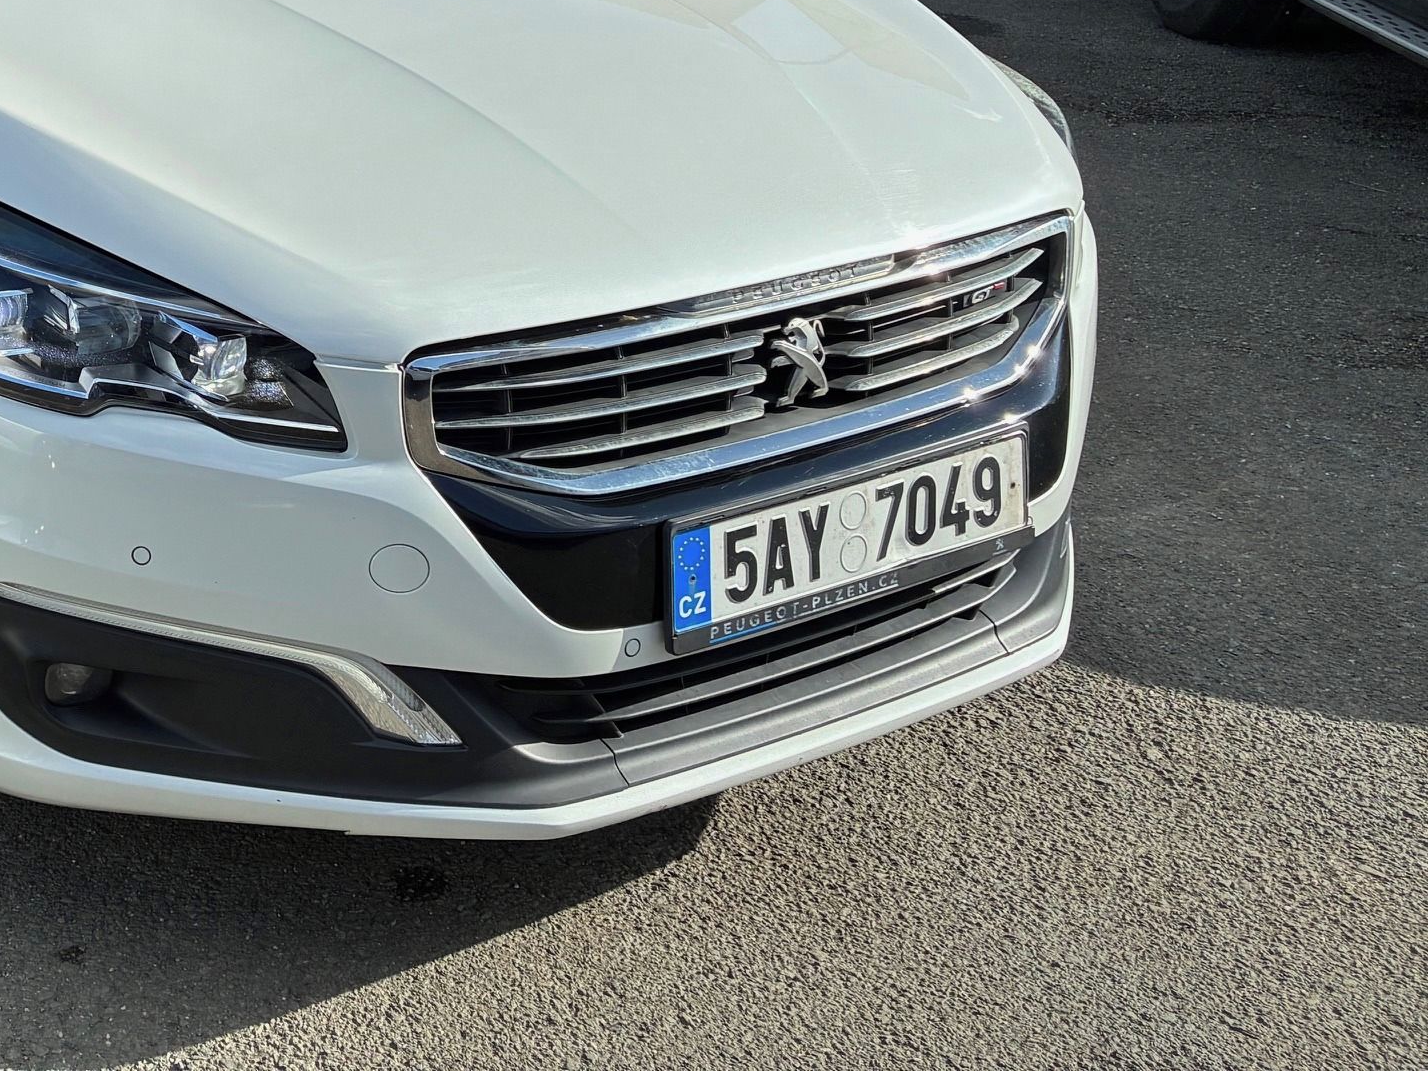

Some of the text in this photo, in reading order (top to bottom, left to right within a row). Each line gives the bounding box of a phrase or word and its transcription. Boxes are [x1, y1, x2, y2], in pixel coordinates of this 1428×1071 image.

[679, 455, 1002, 618] CZ 5AY 7049
